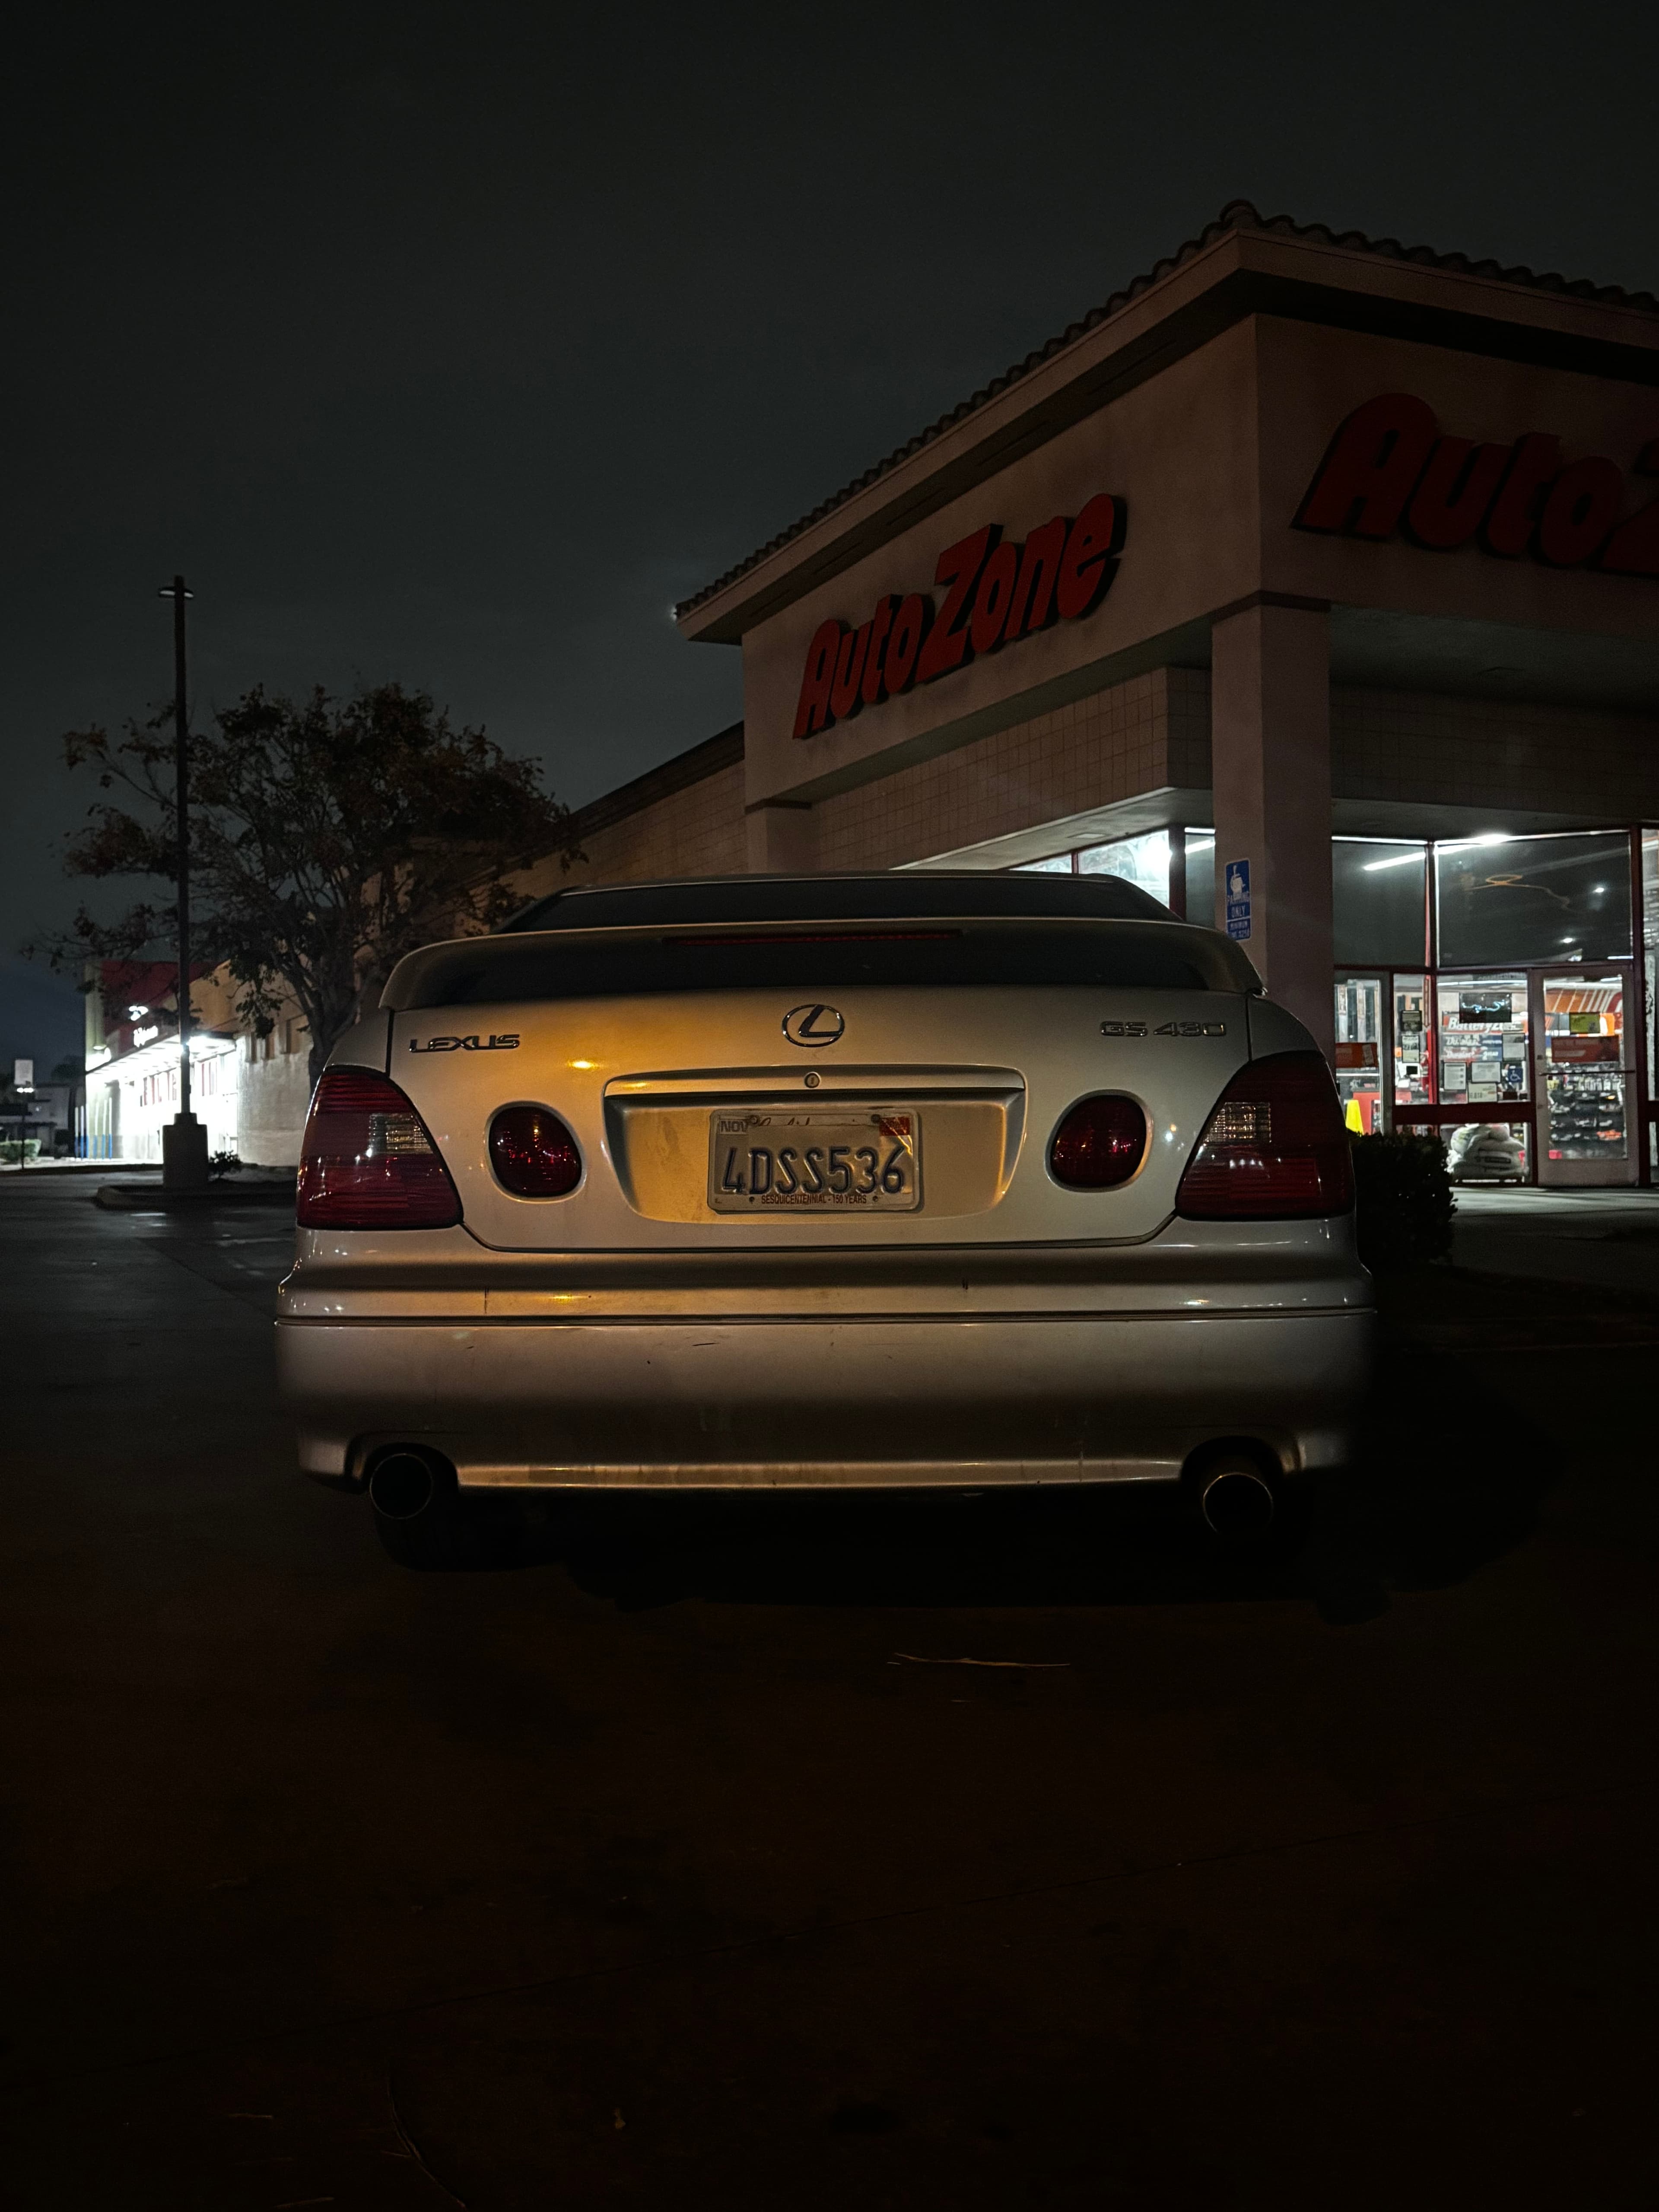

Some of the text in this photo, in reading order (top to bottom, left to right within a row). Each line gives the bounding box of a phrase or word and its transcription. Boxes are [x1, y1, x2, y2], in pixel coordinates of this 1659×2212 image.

[793, 493, 1125, 740] AutoZone
[1231, 905, 1246, 918] ONLY
[1100, 1021, 1226, 1036] GS 430
[409, 1034, 520, 1053] LEXUS
[720, 1120, 748, 1133] NOV
[721, 1146, 905, 1194] 4DSS536
[761, 1193, 826, 1205] SESQUICENTENNIAL
[833, 1194, 842, 1204] 150
[845, 1194, 867, 1204] YEARS
